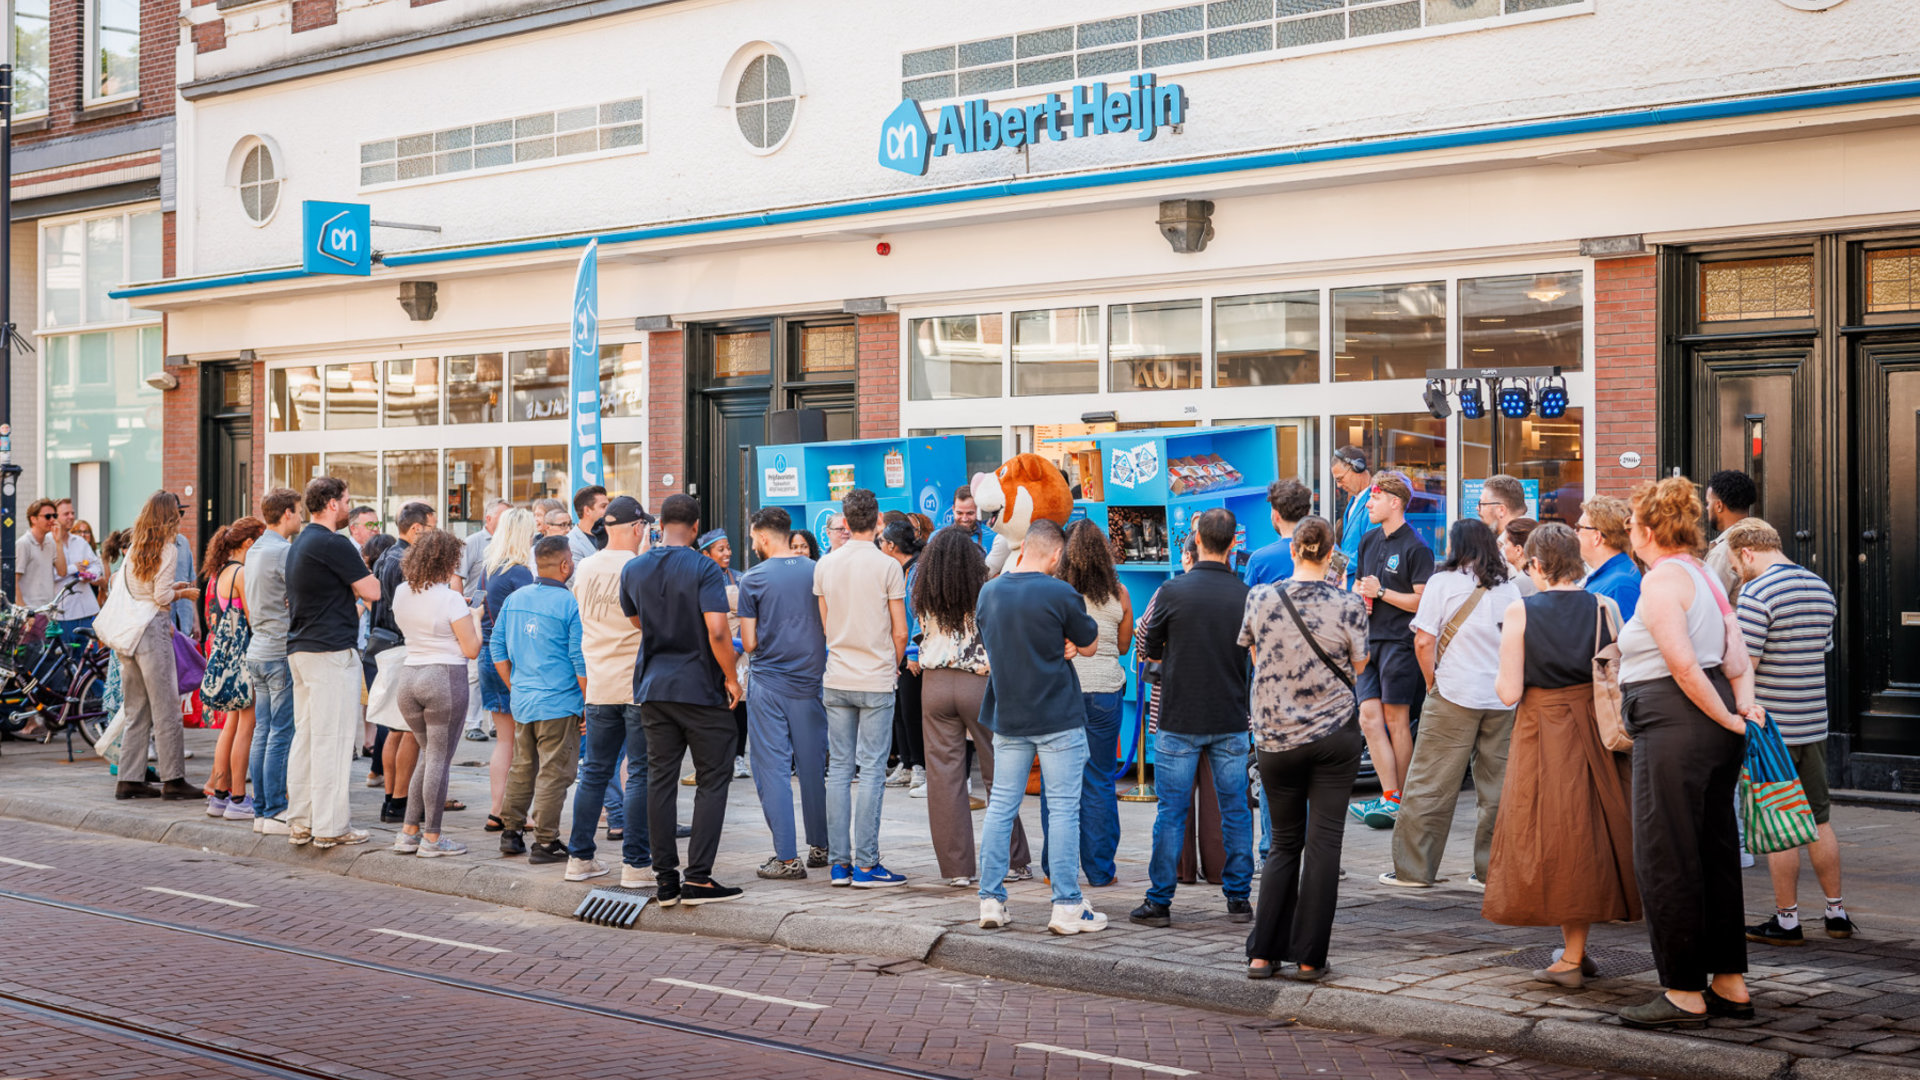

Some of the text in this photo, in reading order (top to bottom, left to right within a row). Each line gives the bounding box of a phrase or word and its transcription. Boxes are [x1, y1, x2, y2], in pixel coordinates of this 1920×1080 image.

[933, 93, 1067, 158] Albert
[1073, 73, 1186, 142] Heijn
[1133, 358, 1230, 389] KOFFE
